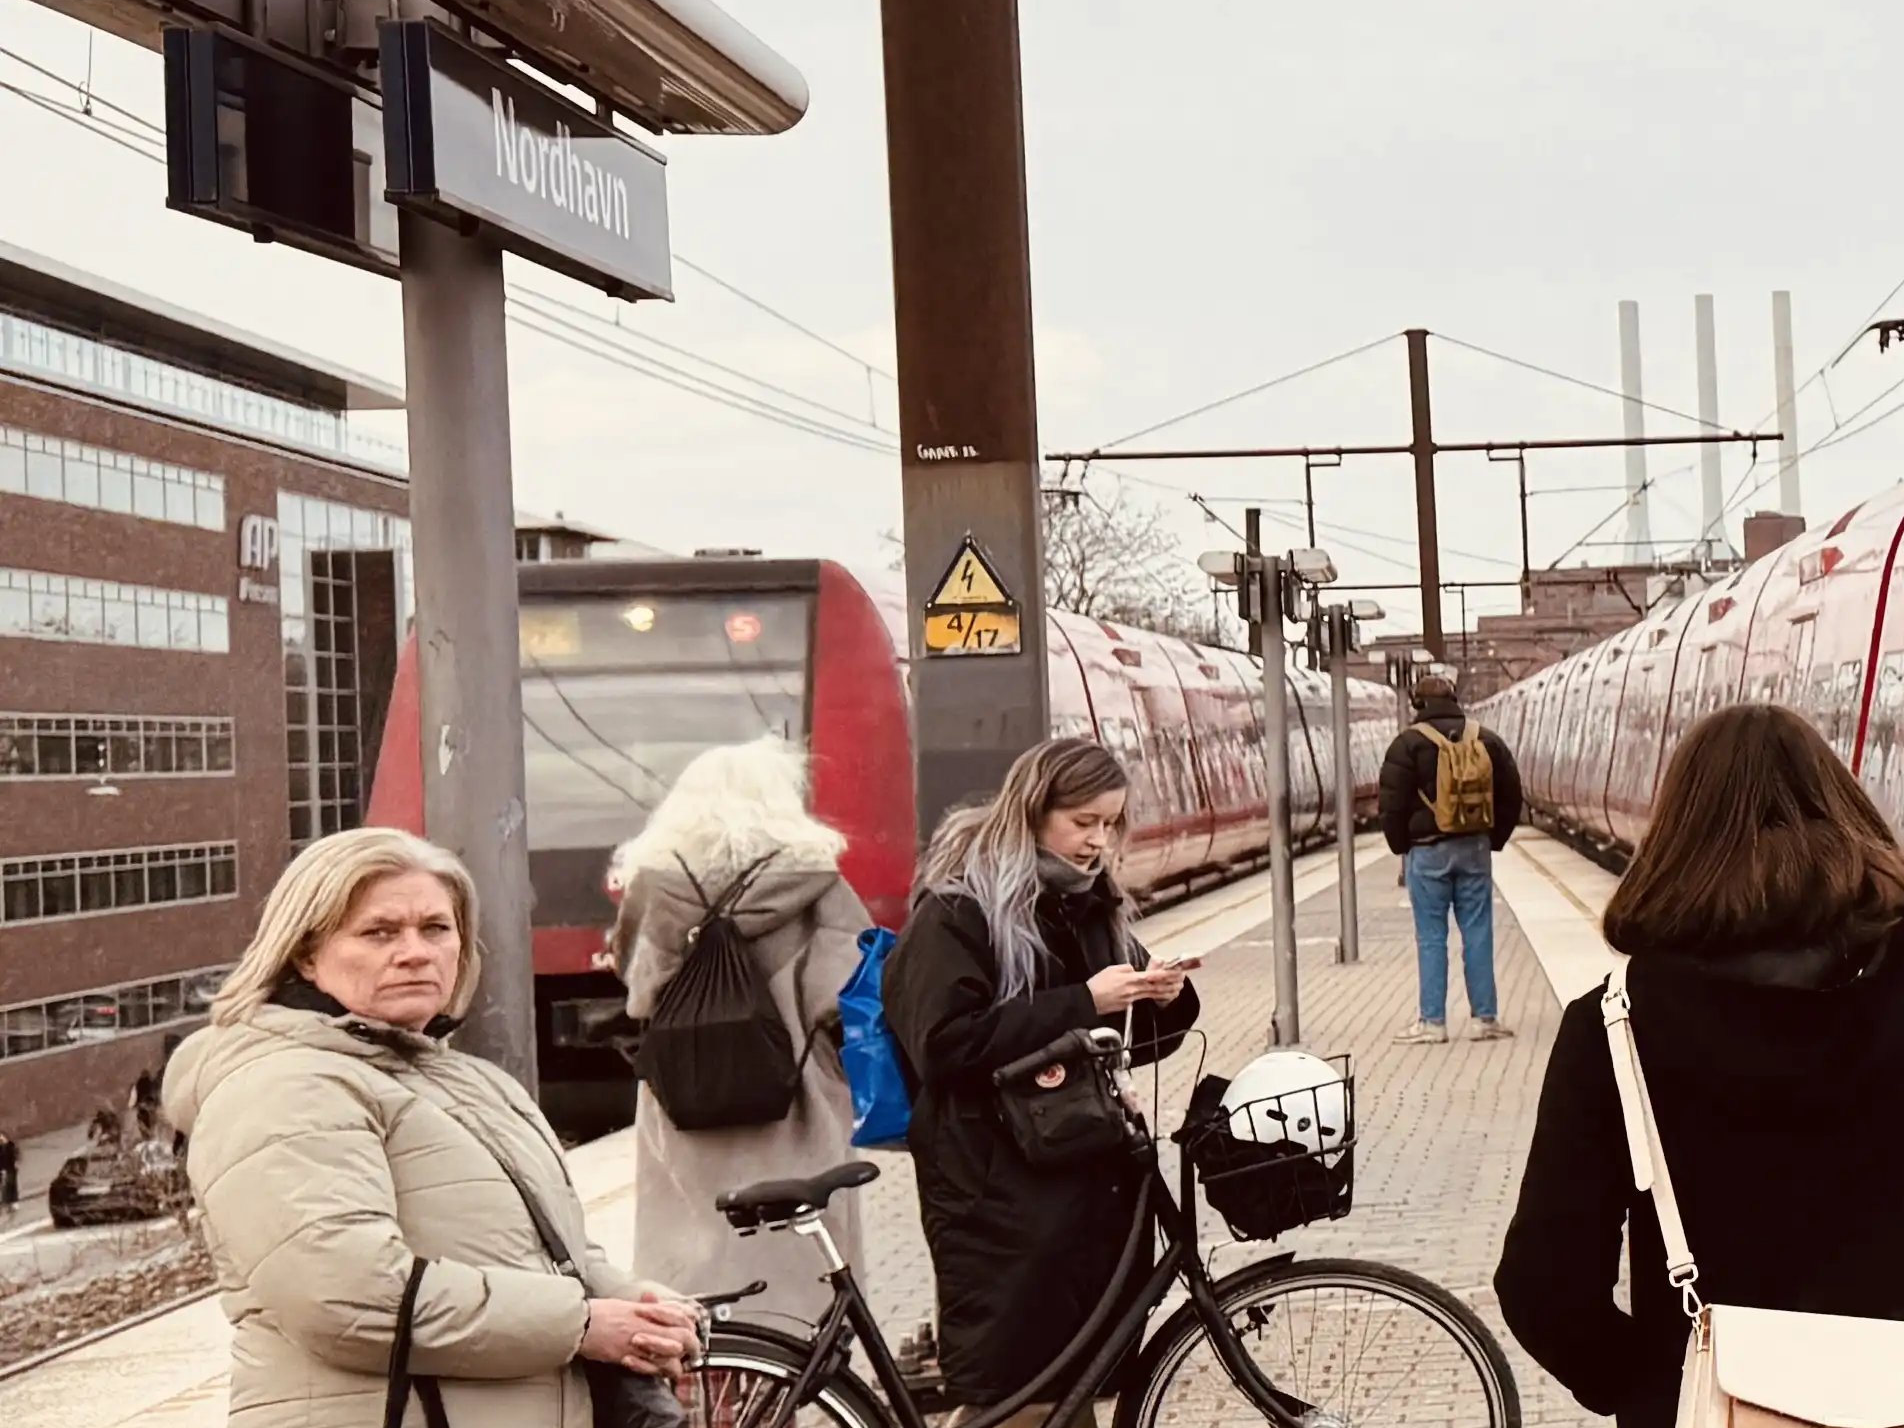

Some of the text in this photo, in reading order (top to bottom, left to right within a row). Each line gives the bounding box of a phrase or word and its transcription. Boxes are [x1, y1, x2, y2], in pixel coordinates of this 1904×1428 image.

[491, 86, 630, 240] Nordhavn
[240, 514, 279, 571] AP
[946, 613, 999, 649] 4/17
